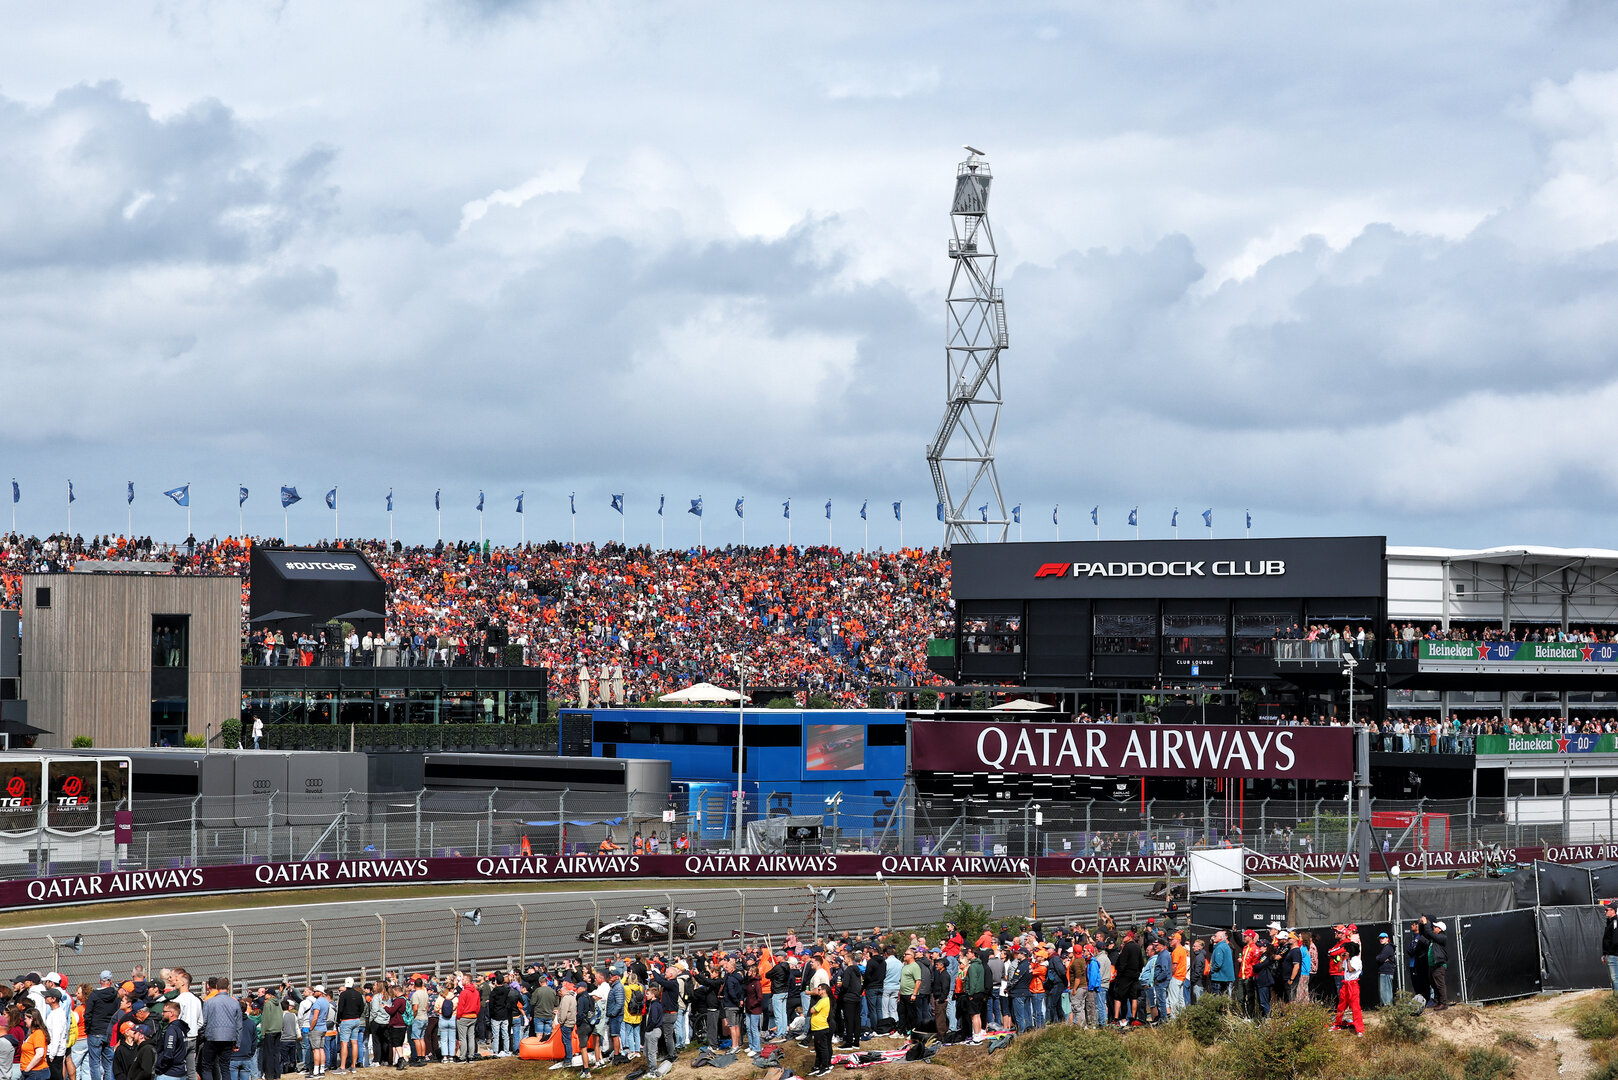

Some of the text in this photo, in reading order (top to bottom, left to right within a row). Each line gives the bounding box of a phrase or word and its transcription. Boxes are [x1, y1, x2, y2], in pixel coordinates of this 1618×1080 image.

[285, 561, 357, 571] #DUTCHGP
[1073, 561, 1206, 577] PADDOCK
[1211, 560, 1286, 576] CLUB
[1428, 643, 1474, 657] Heineken
[1535, 645, 1578, 658] Heineken
[976, 727, 1296, 771] QATAR AIRWAYS
[1508, 738, 1553, 751] Heineken
[0, 797, 33, 807] TGR
[56, 796, 89, 806] TGR
[1245, 854, 1360, 871] QATAR AIRWAY
[1404, 851, 1454, 867] QATAR
[1547, 846, 1594, 862] QATAR
[255, 859, 429, 885] QATAR AIRWAYS
[476, 856, 640, 877] QATAR AIRWAYS
[685, 856, 838, 874] QATAR AIRWAYS
[881, 856, 1030, 873] QATAR AIRWAYS
[1071, 857, 1131, 874] QATAR
[27, 868, 204, 901] QATAR AIRWAYS
